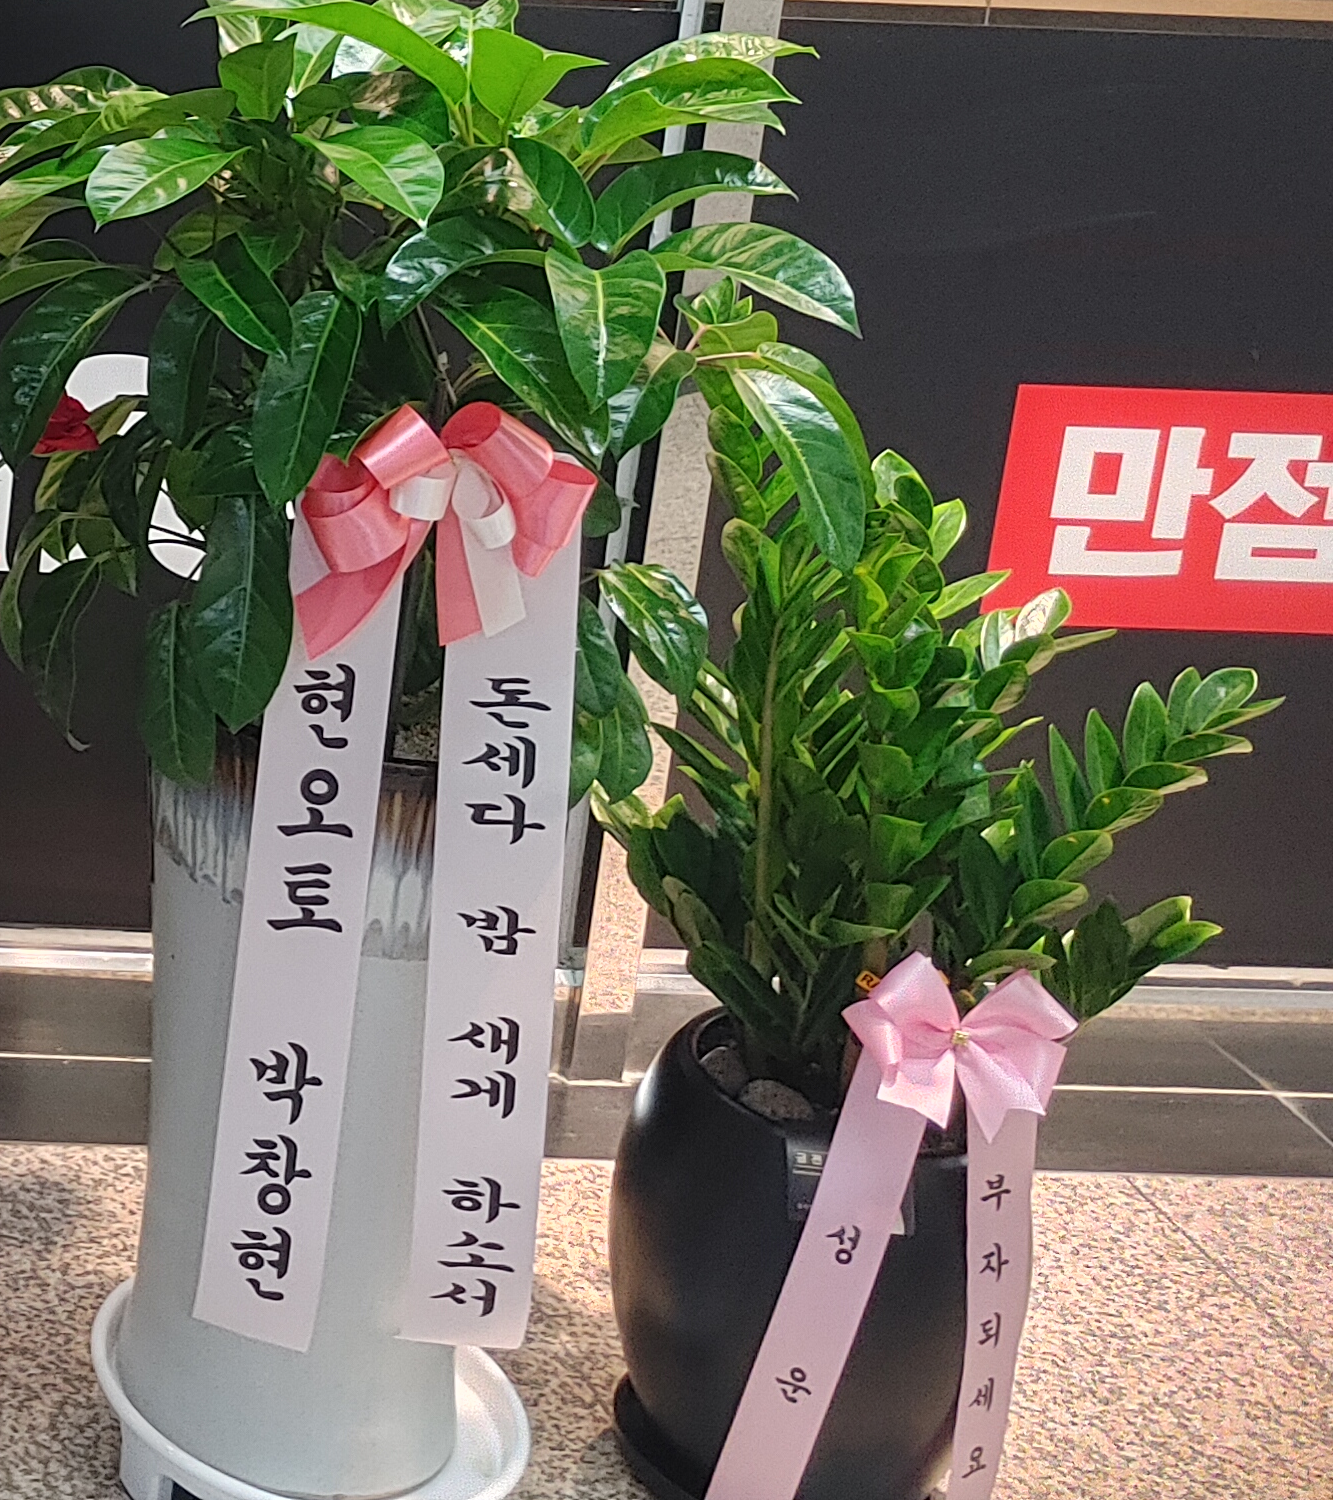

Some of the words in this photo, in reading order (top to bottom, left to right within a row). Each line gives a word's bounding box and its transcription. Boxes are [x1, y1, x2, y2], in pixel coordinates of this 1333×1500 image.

[1047, 425, 1333, 583] 만점
[266, 662, 357, 934] 현오토
[462, 676, 552, 846] 돈세다
[458, 905, 536, 956] 밤
[448, 1016, 520, 1120] 새게
[230, 1041, 323, 1303] 박창현
[430, 1176, 521, 1318] 하소서
[961, 1173, 1012, 1479] 부자되세요
